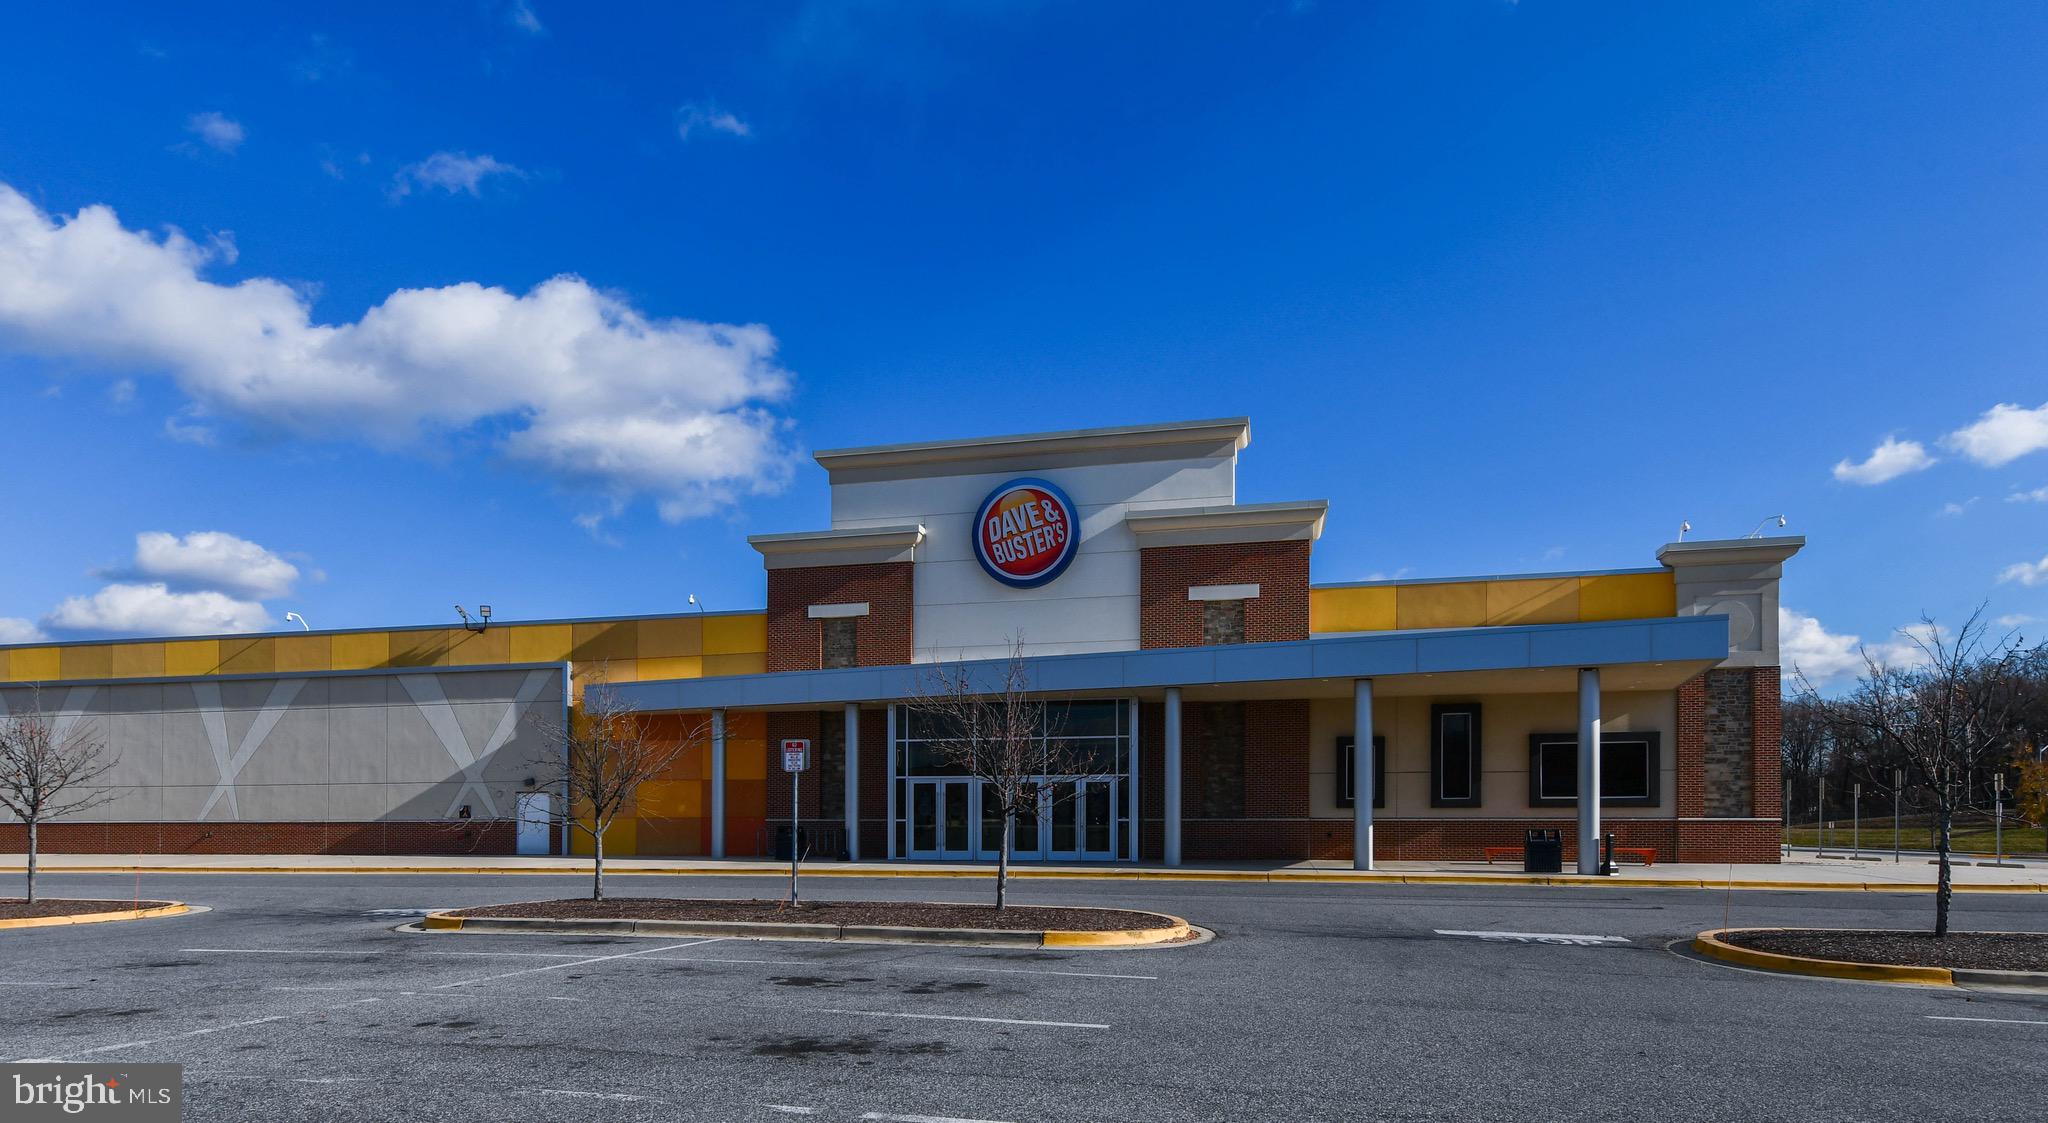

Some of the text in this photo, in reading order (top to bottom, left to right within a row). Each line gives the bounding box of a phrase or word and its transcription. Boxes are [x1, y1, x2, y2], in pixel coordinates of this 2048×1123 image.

[989, 499, 1061, 543] DAVE &
[992, 523, 1065, 564] BUSTER'S
